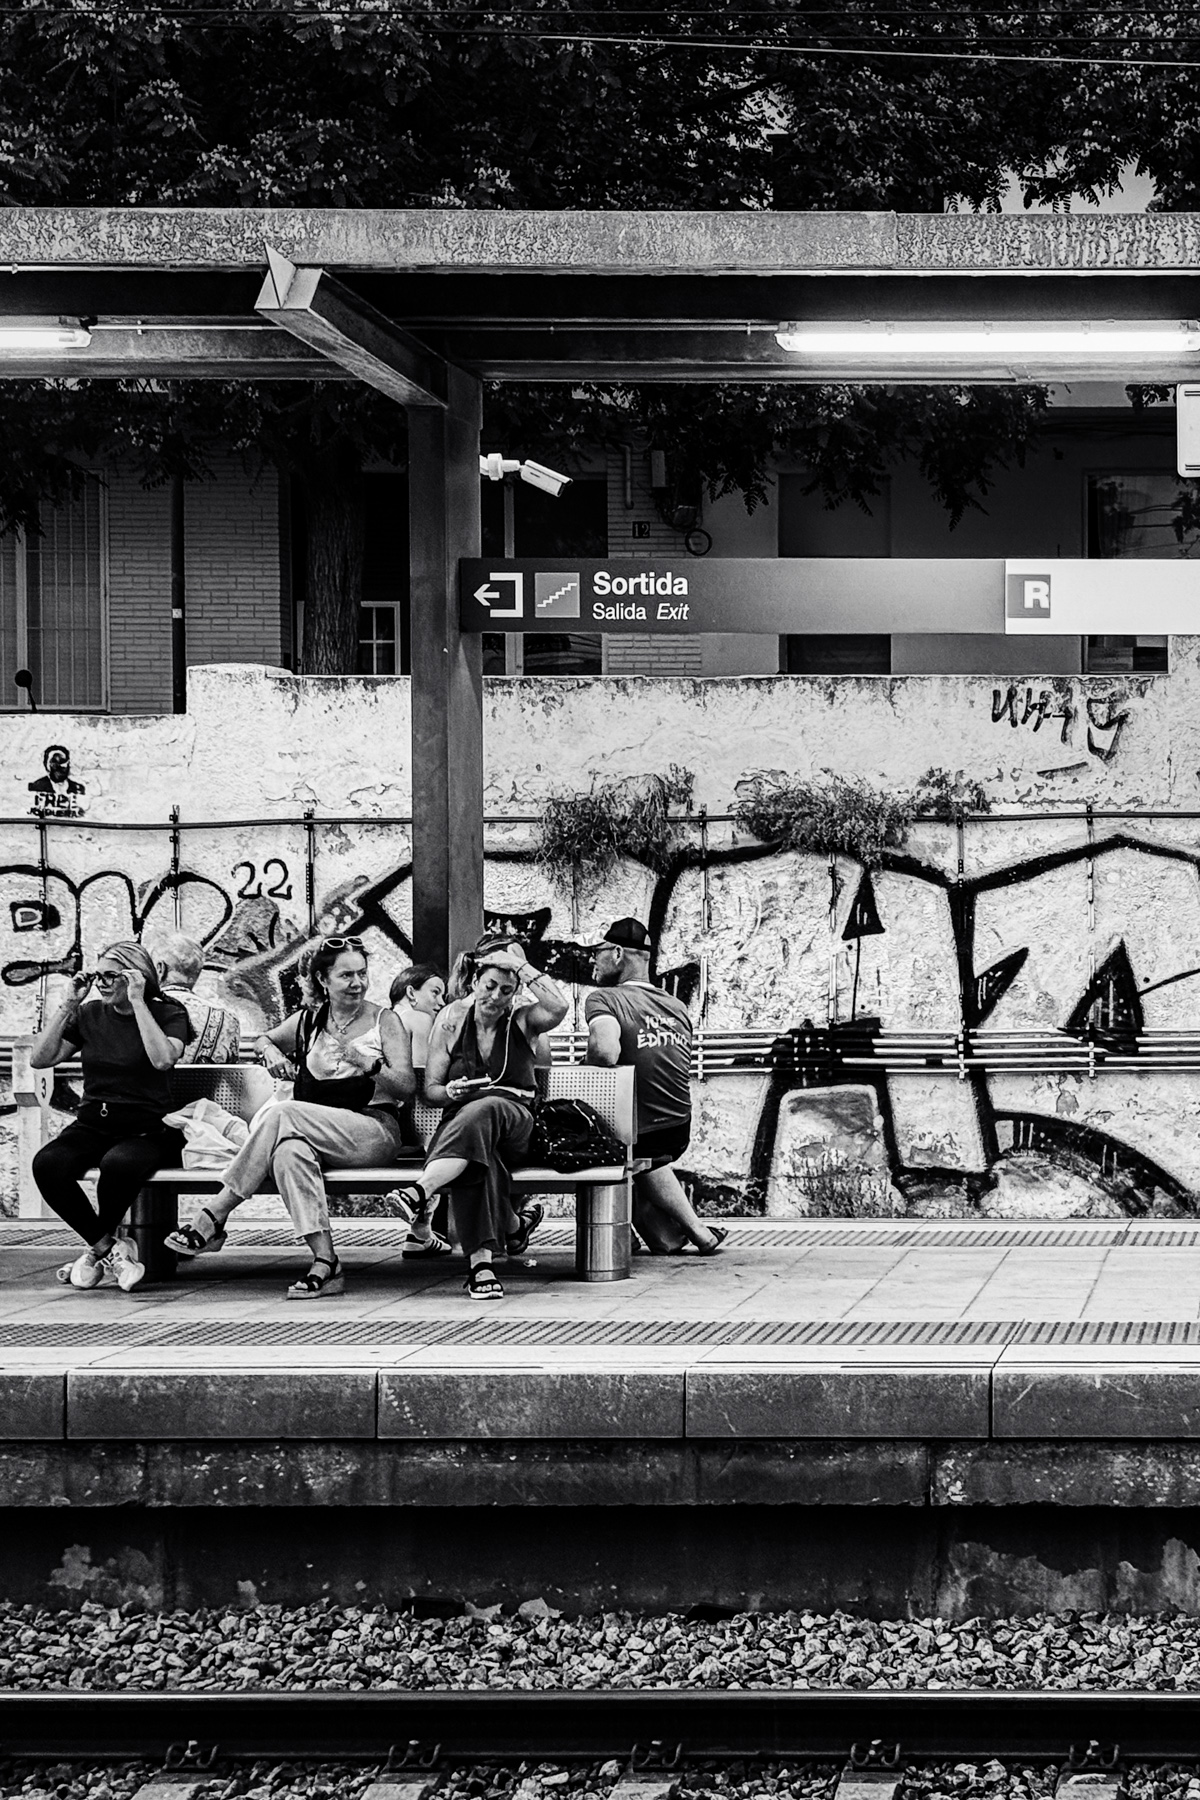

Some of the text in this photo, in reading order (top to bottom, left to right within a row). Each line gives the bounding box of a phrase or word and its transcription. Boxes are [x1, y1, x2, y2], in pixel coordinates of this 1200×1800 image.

[634, 523, 649, 537] 12
[592, 571, 689, 596] Sortida
[592, 603, 690, 620] Salida Exit
[231, 857, 293, 900] 22
[41, 1077, 47, 1099] 3
